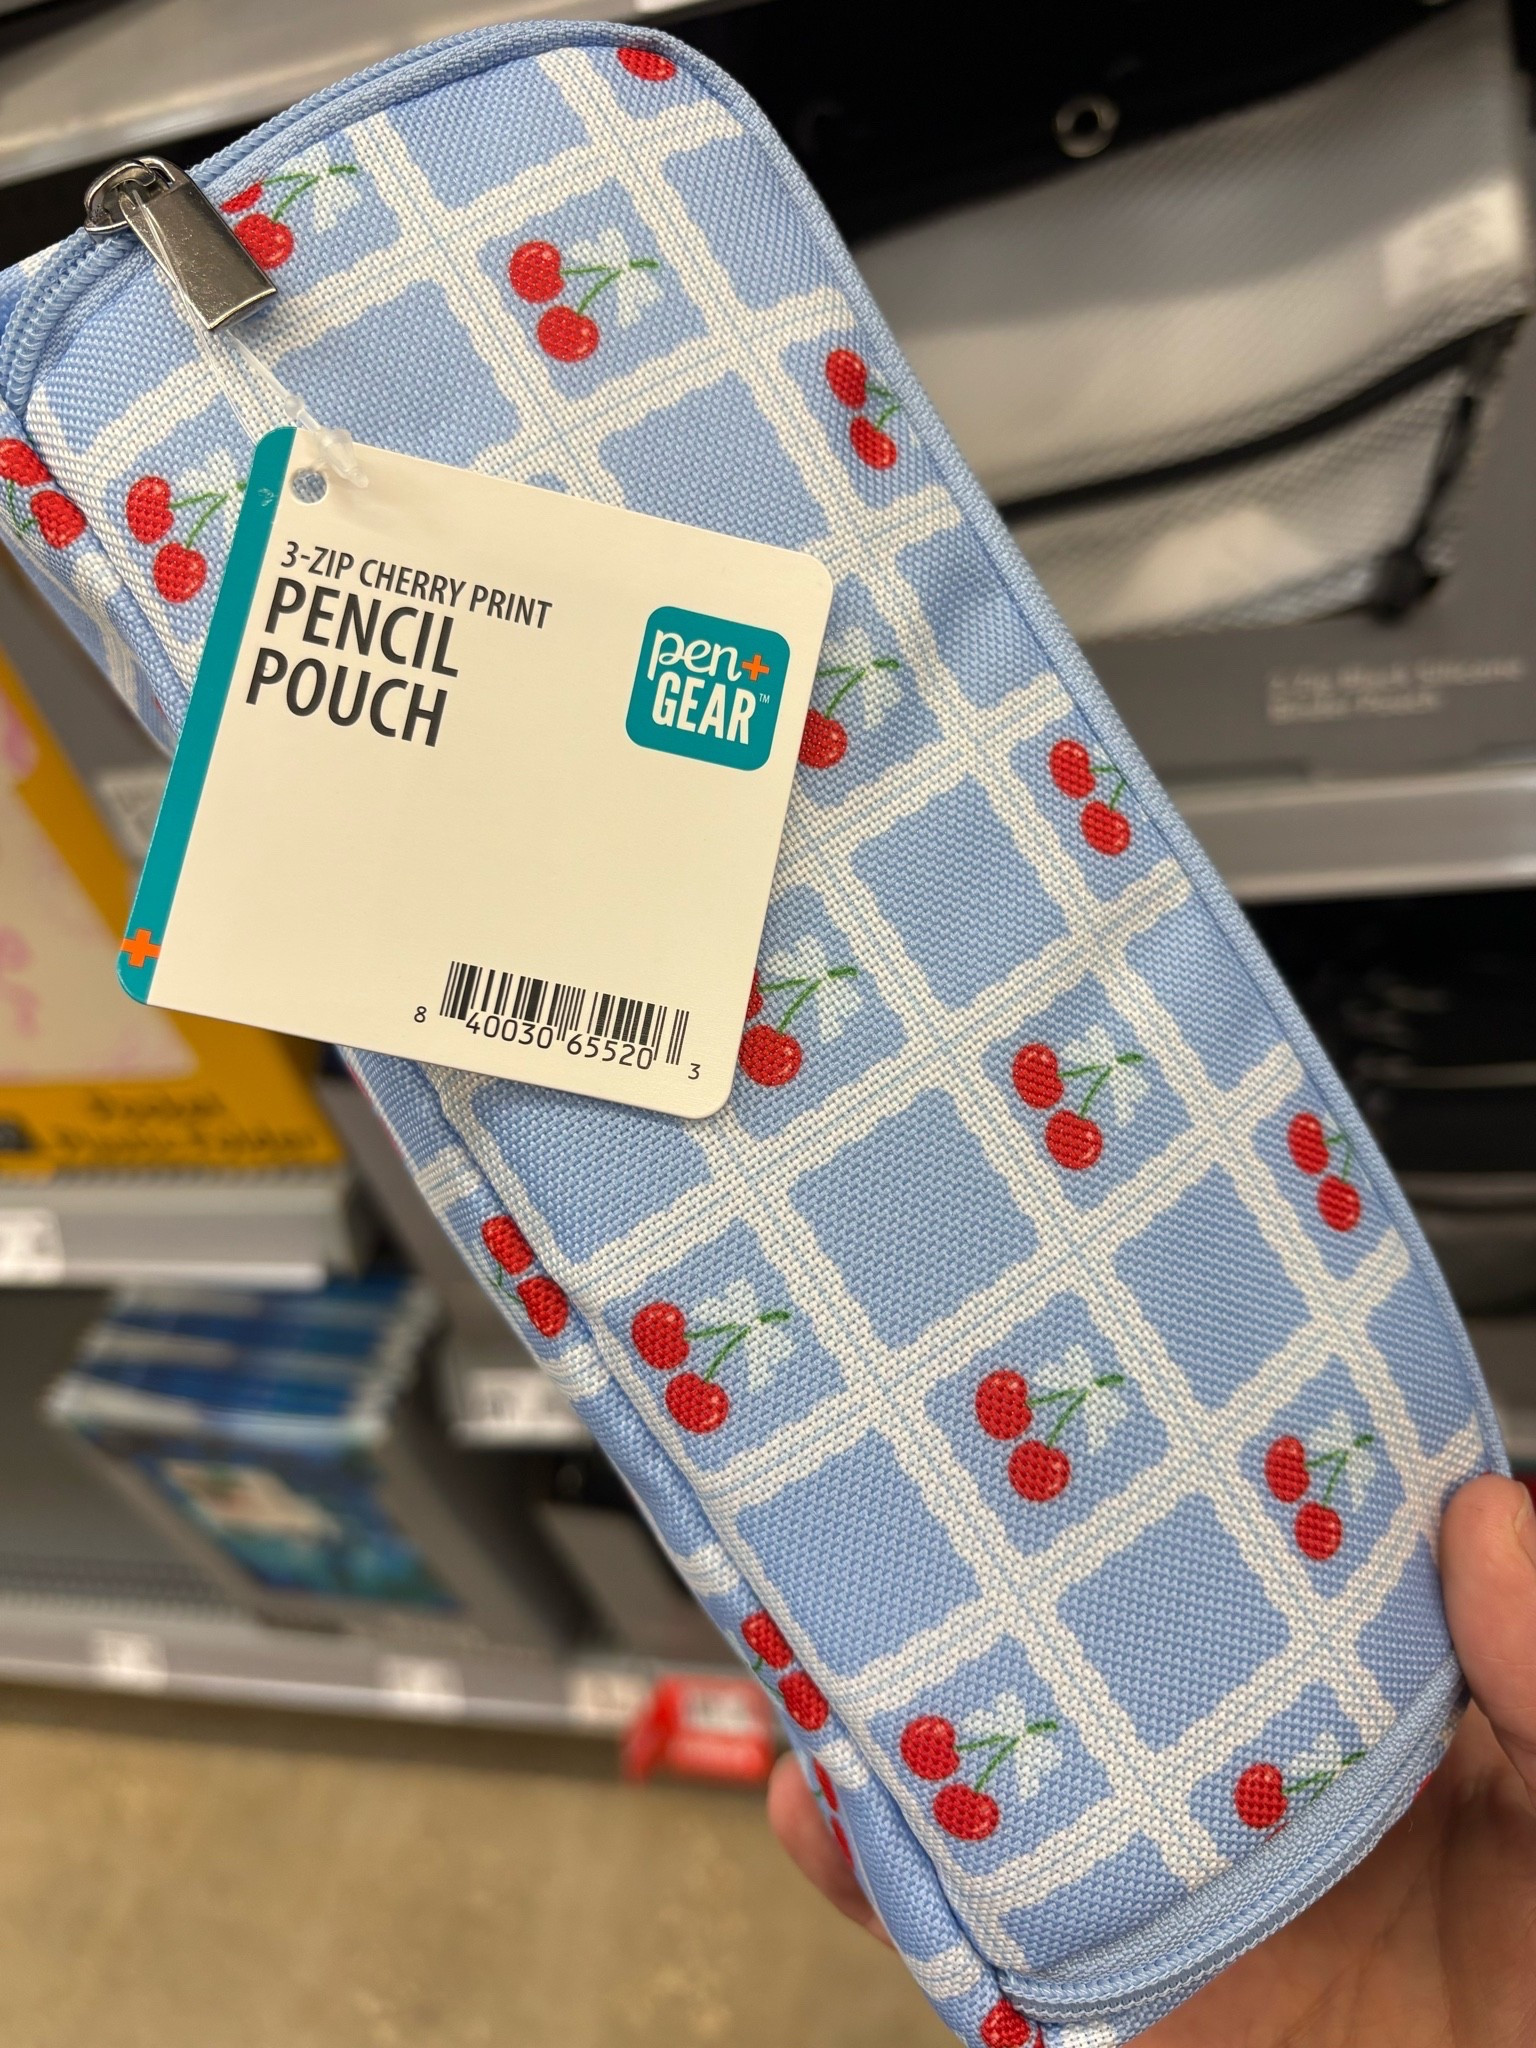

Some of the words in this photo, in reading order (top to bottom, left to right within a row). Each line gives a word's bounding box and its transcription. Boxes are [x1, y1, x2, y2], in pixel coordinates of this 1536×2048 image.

[264, 577, 459, 677] PENCIL
[281, 541, 355, 579] 3-ZIP
[359, 559, 466, 607] CHERRY
[469, 585, 553, 629] PRINT
[245, 647, 448, 747] POUCH
[414, 1006, 427, 1023] 8
[465, 1012, 554, 1049] 40030
[566, 1034, 654, 1070] 65520
[687, 1063, 701, 1080] 3
